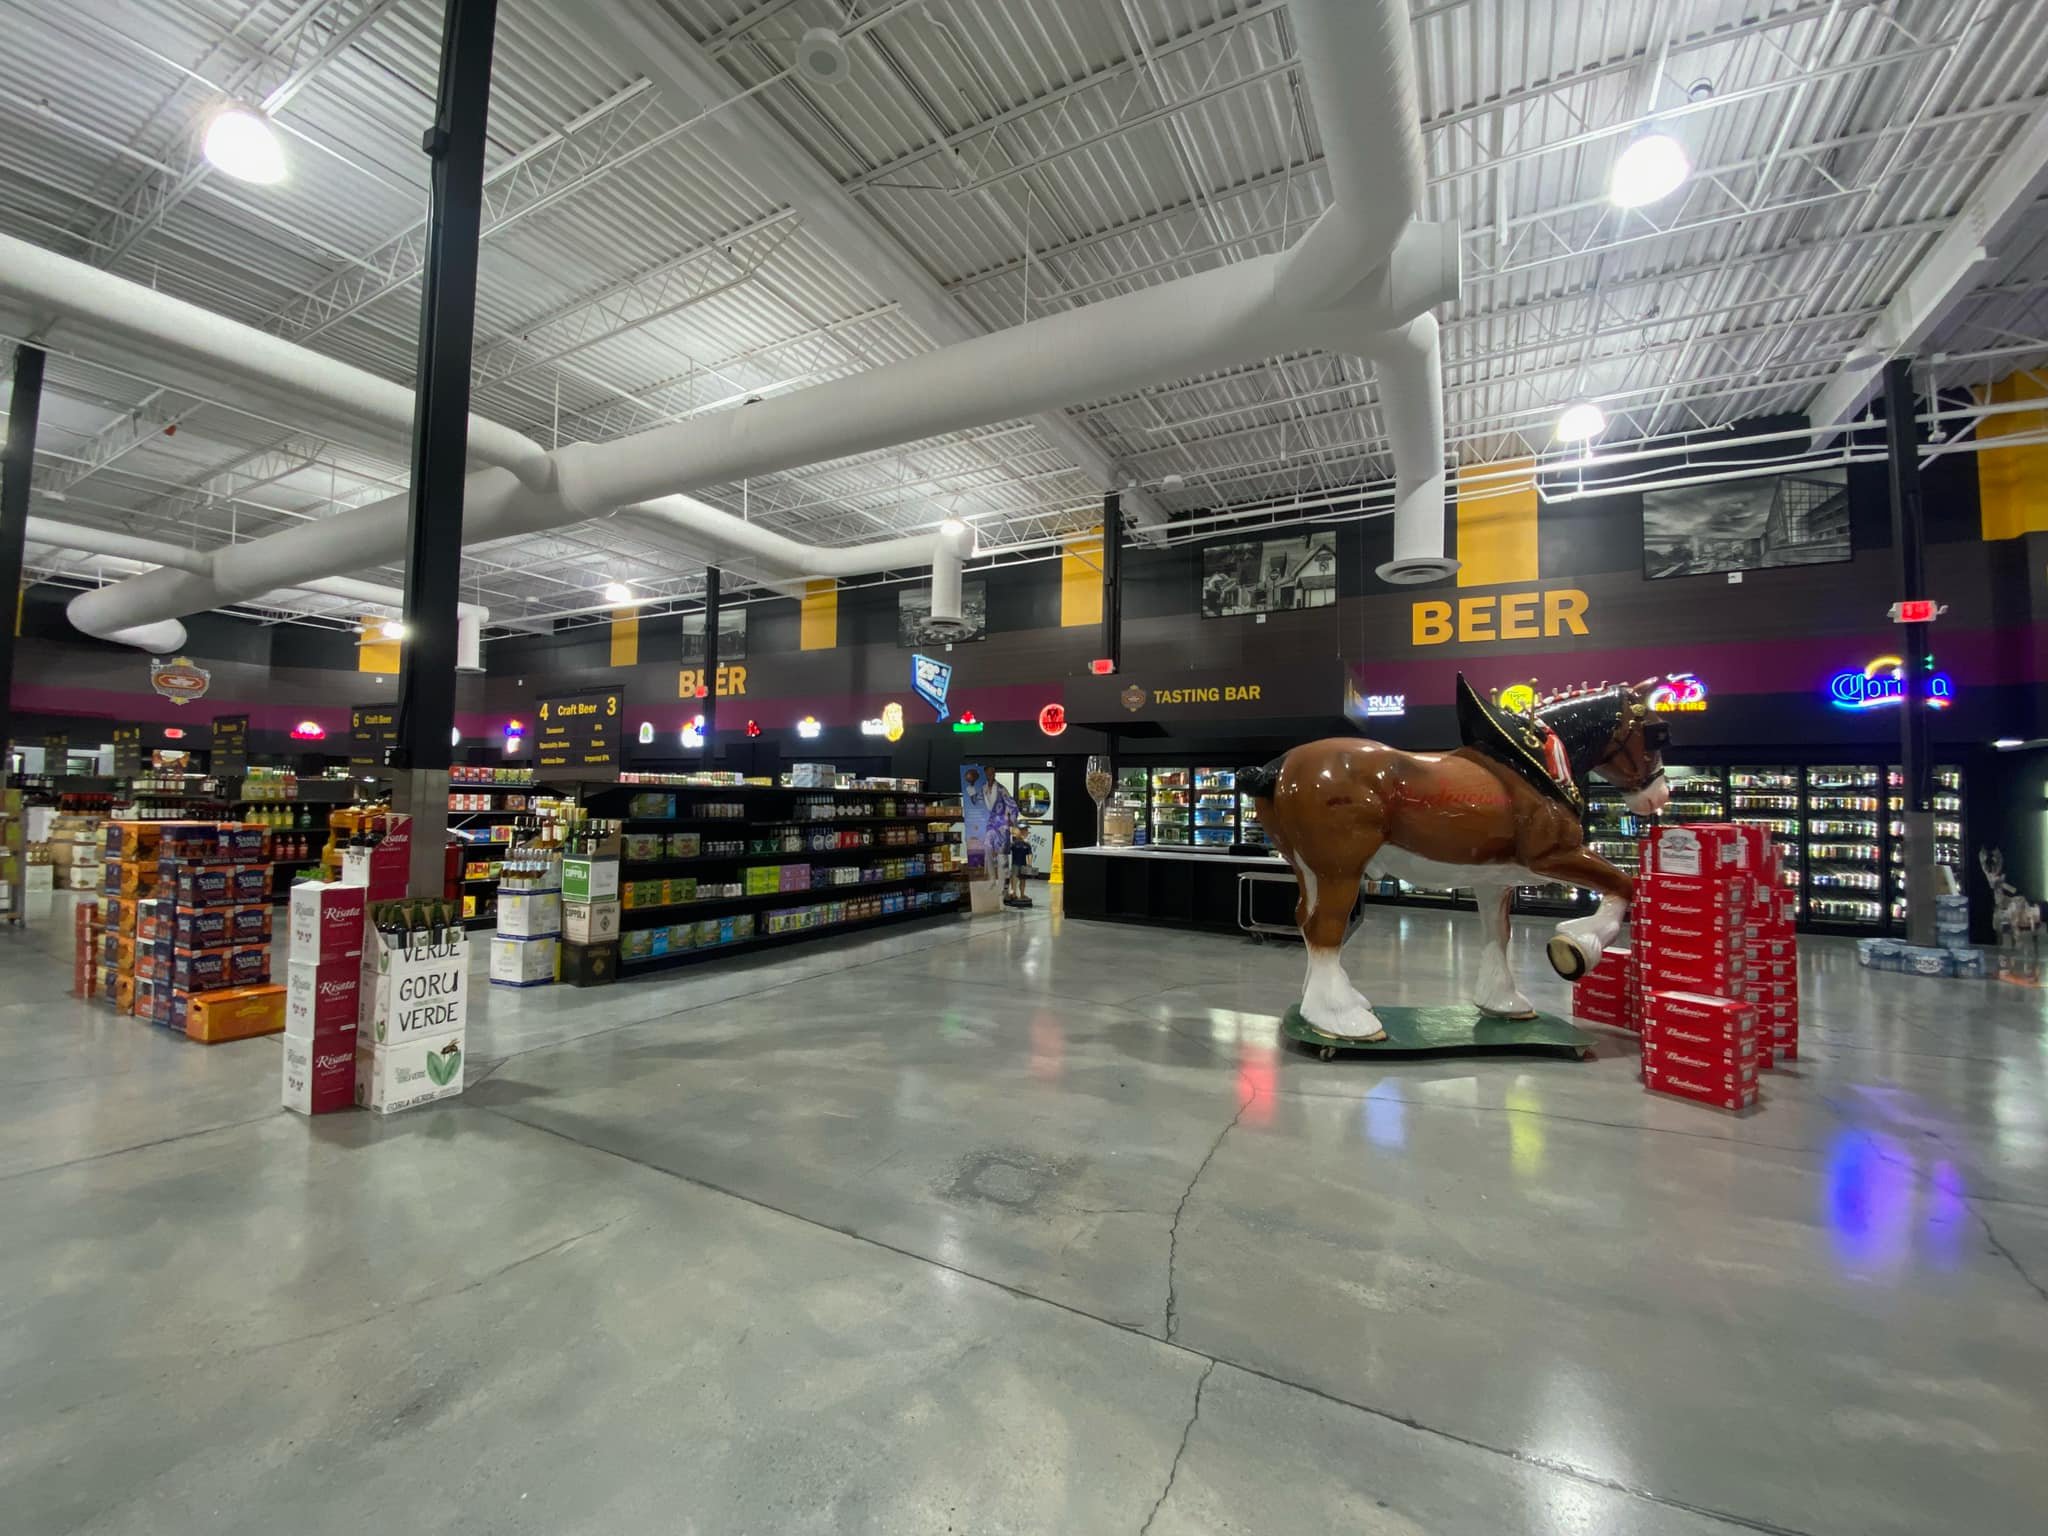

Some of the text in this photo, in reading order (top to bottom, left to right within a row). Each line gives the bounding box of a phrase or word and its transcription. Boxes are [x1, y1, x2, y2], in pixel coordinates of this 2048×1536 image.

[1412, 589, 1590, 646] BEER
[1153, 685, 1261, 704] TASTING BAR
[1368, 695, 1405, 707] RULY.
[539, 696, 617, 721] 4 Craft Beer 3
[353, 713, 360, 728] 6
[324, 906, 361, 921] Risata
[402, 943, 461, 963] VERDE
[319, 981, 357, 995] Risata
[400, 969, 459, 1001] GORU
[399, 1001, 459, 1032] VERDE
[315, 1053, 353, 1068] Risata
